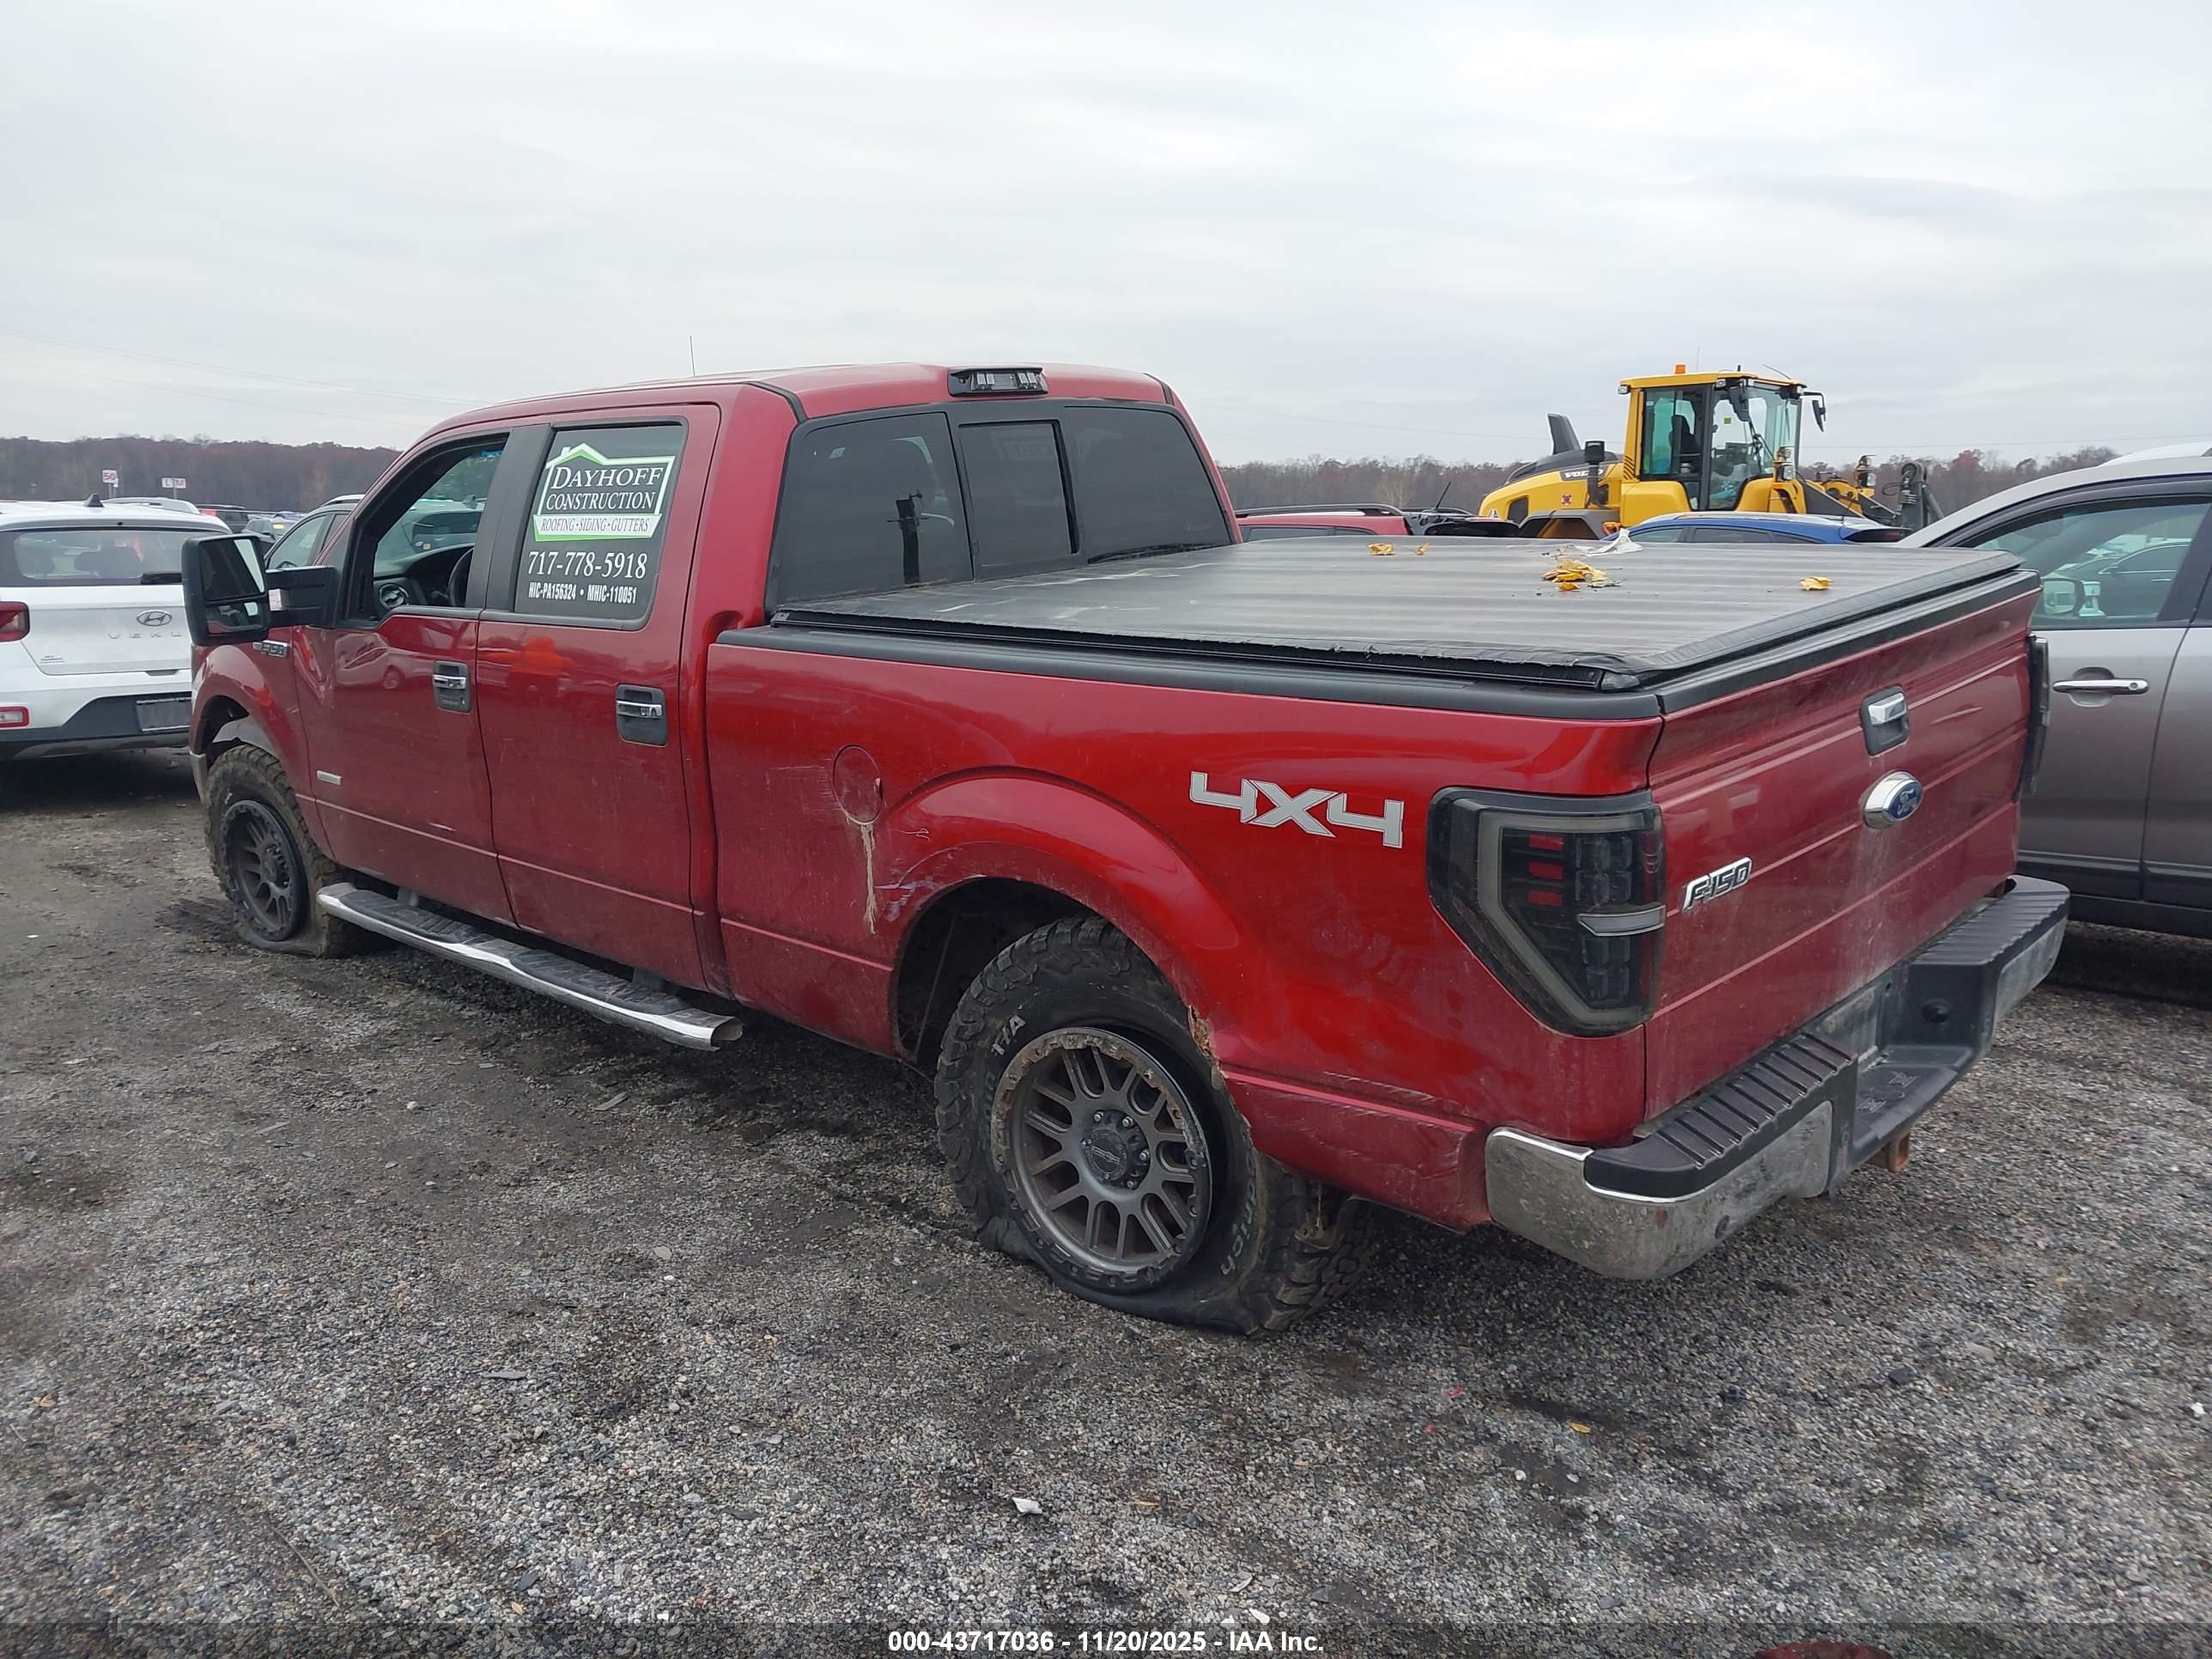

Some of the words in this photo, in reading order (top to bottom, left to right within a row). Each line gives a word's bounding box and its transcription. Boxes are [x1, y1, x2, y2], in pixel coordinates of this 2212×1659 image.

[550, 466, 664, 489] DAYHOFF
[1565, 469, 1604, 477] VOLO
[546, 491, 656, 510] CONSTRUCTION
[541, 518, 574, 532] ROOFING
[580, 518, 607, 532] SIDING
[611, 518, 648, 532] GUTTERS
[528, 550, 647, 579] 717-778-5918
[586, 584, 637, 604] MHIC-110051
